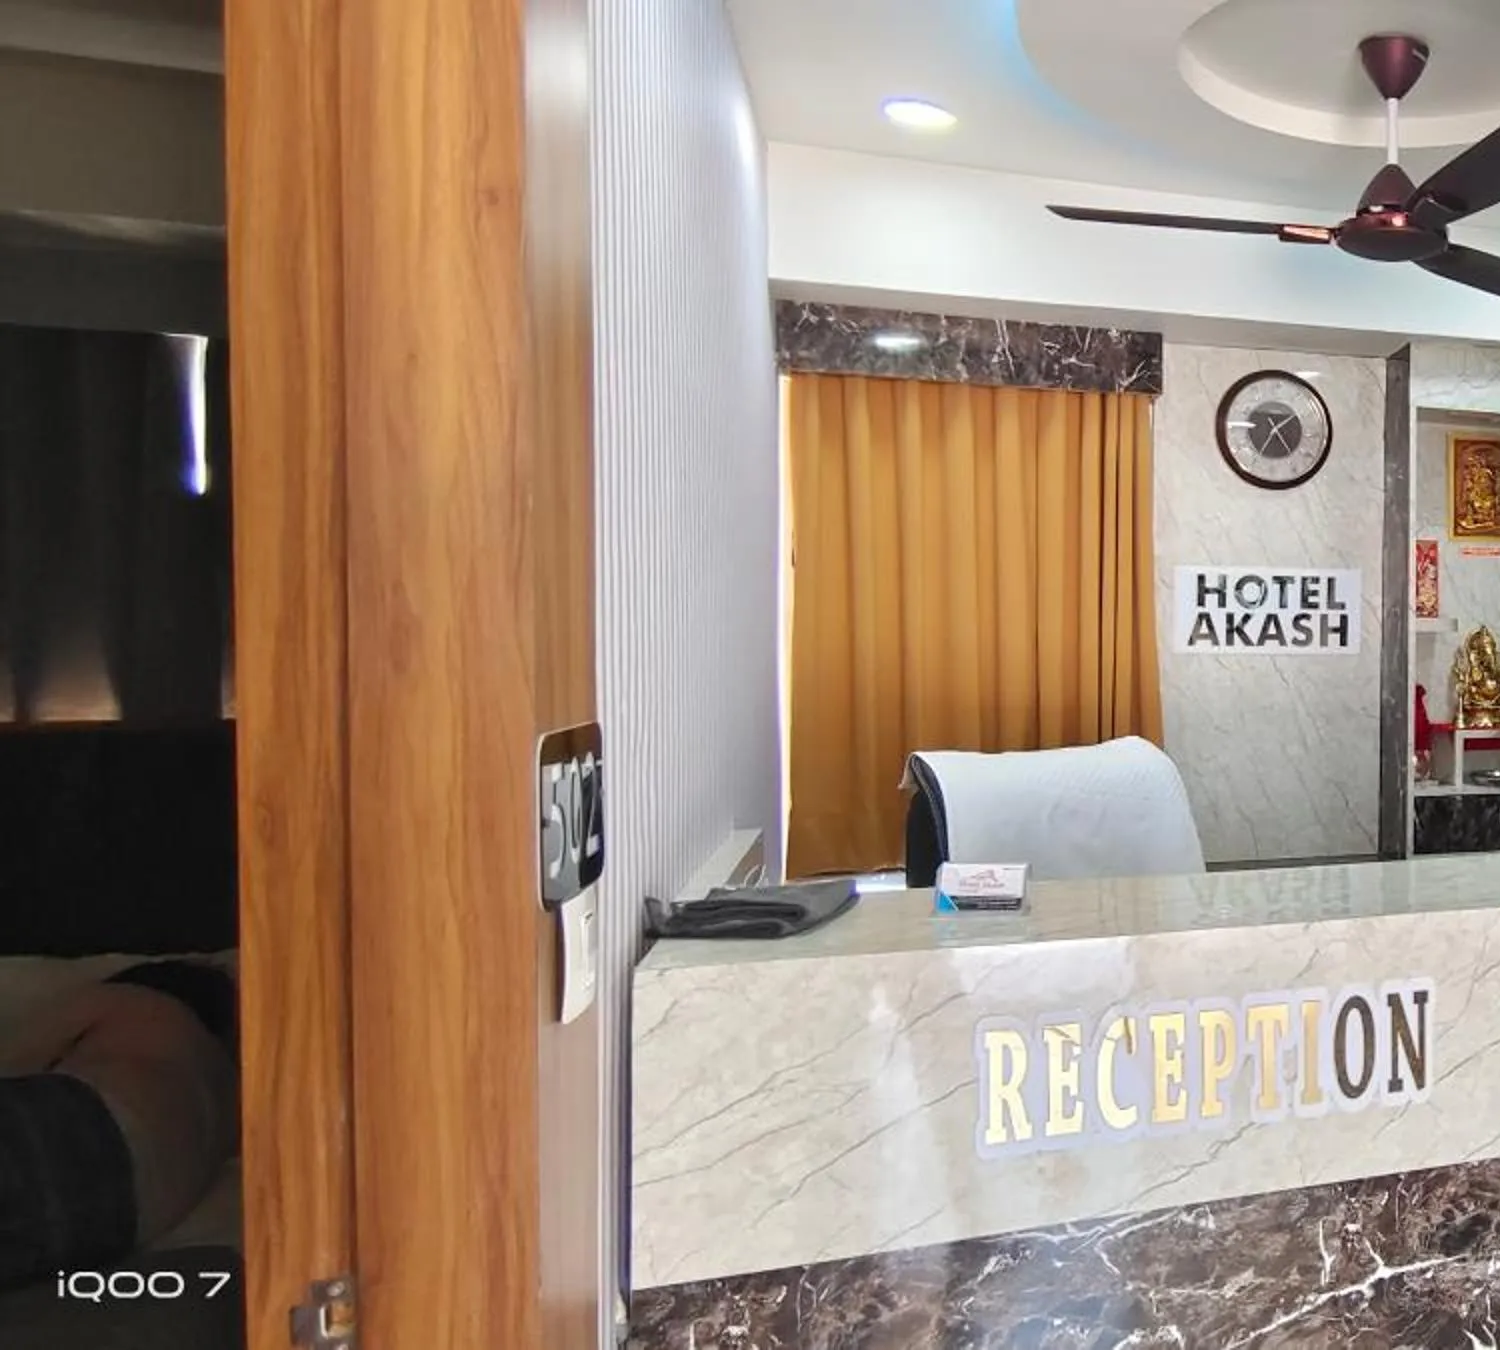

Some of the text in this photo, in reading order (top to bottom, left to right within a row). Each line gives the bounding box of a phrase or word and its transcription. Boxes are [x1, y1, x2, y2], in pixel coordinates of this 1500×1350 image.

[1187, 612, 1349, 647] AKASH
[1196, 573, 1346, 610] HOTEL
[543, 751, 600, 879] 502
[984, 990, 1428, 1145] RECEPTION
